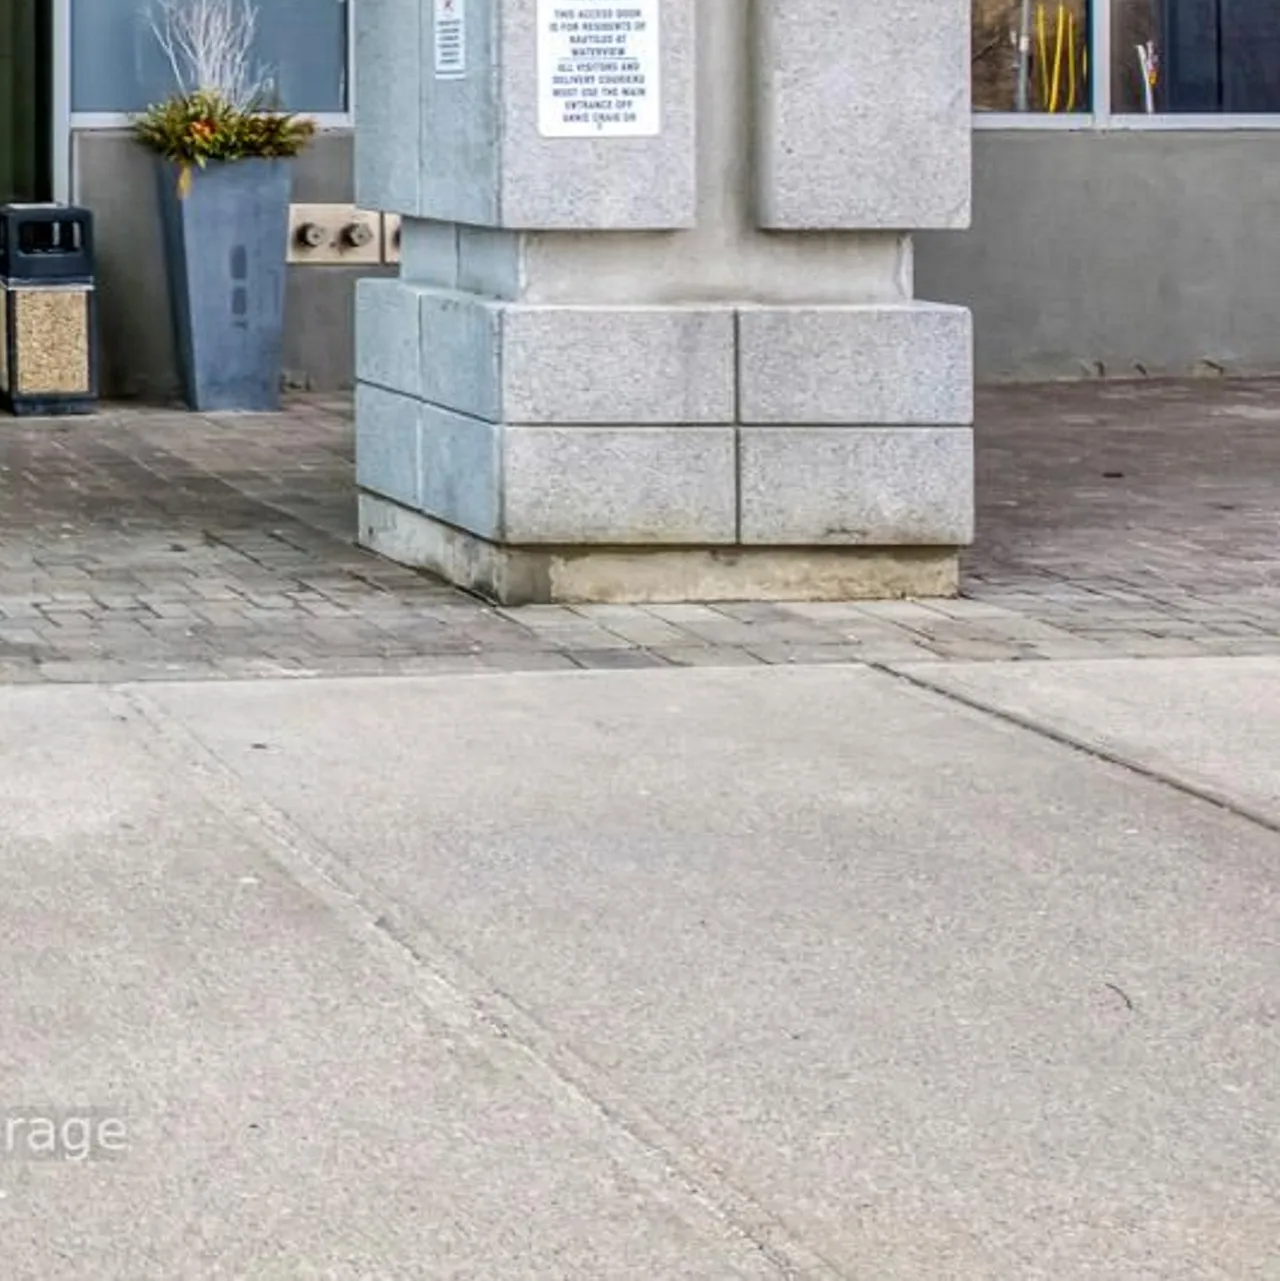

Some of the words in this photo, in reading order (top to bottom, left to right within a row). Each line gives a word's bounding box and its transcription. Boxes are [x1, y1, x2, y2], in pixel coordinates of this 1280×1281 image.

[554, 10, 574, 18] THIS
[569, 35, 613, 43] NAUTILUS
[553, 76, 594, 84] DELIVERY
[565, 100, 612, 109] ENTRANCE
